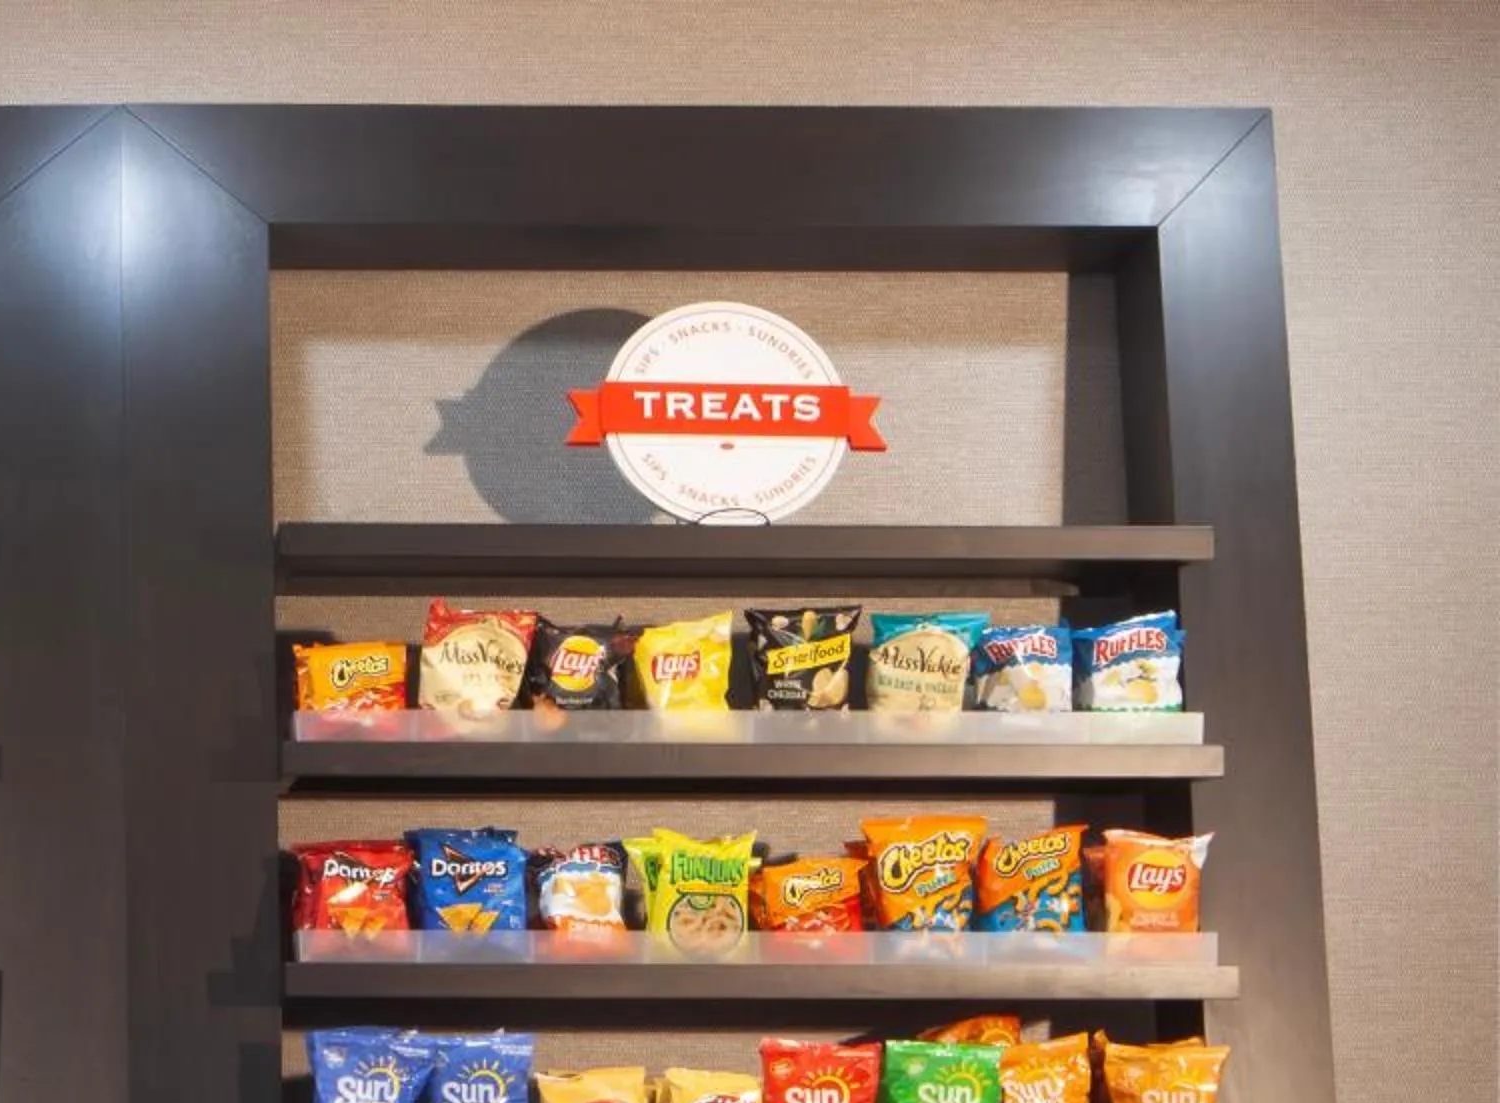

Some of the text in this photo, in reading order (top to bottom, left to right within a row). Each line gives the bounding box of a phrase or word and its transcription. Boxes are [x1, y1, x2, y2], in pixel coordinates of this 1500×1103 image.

[635, 321, 813, 380] SIPS SNACKS SUNDRIES
[633, 390, 821, 422] TREATS
[642, 453, 818, 507] SIPS SNACKS SUNDRIES
[1094, 626, 1167, 665] RUFFLES
[431, 857, 508, 877] Doritos
[878, 831, 972, 892] Cheetos
[994, 831, 1071, 877] Cheetos
